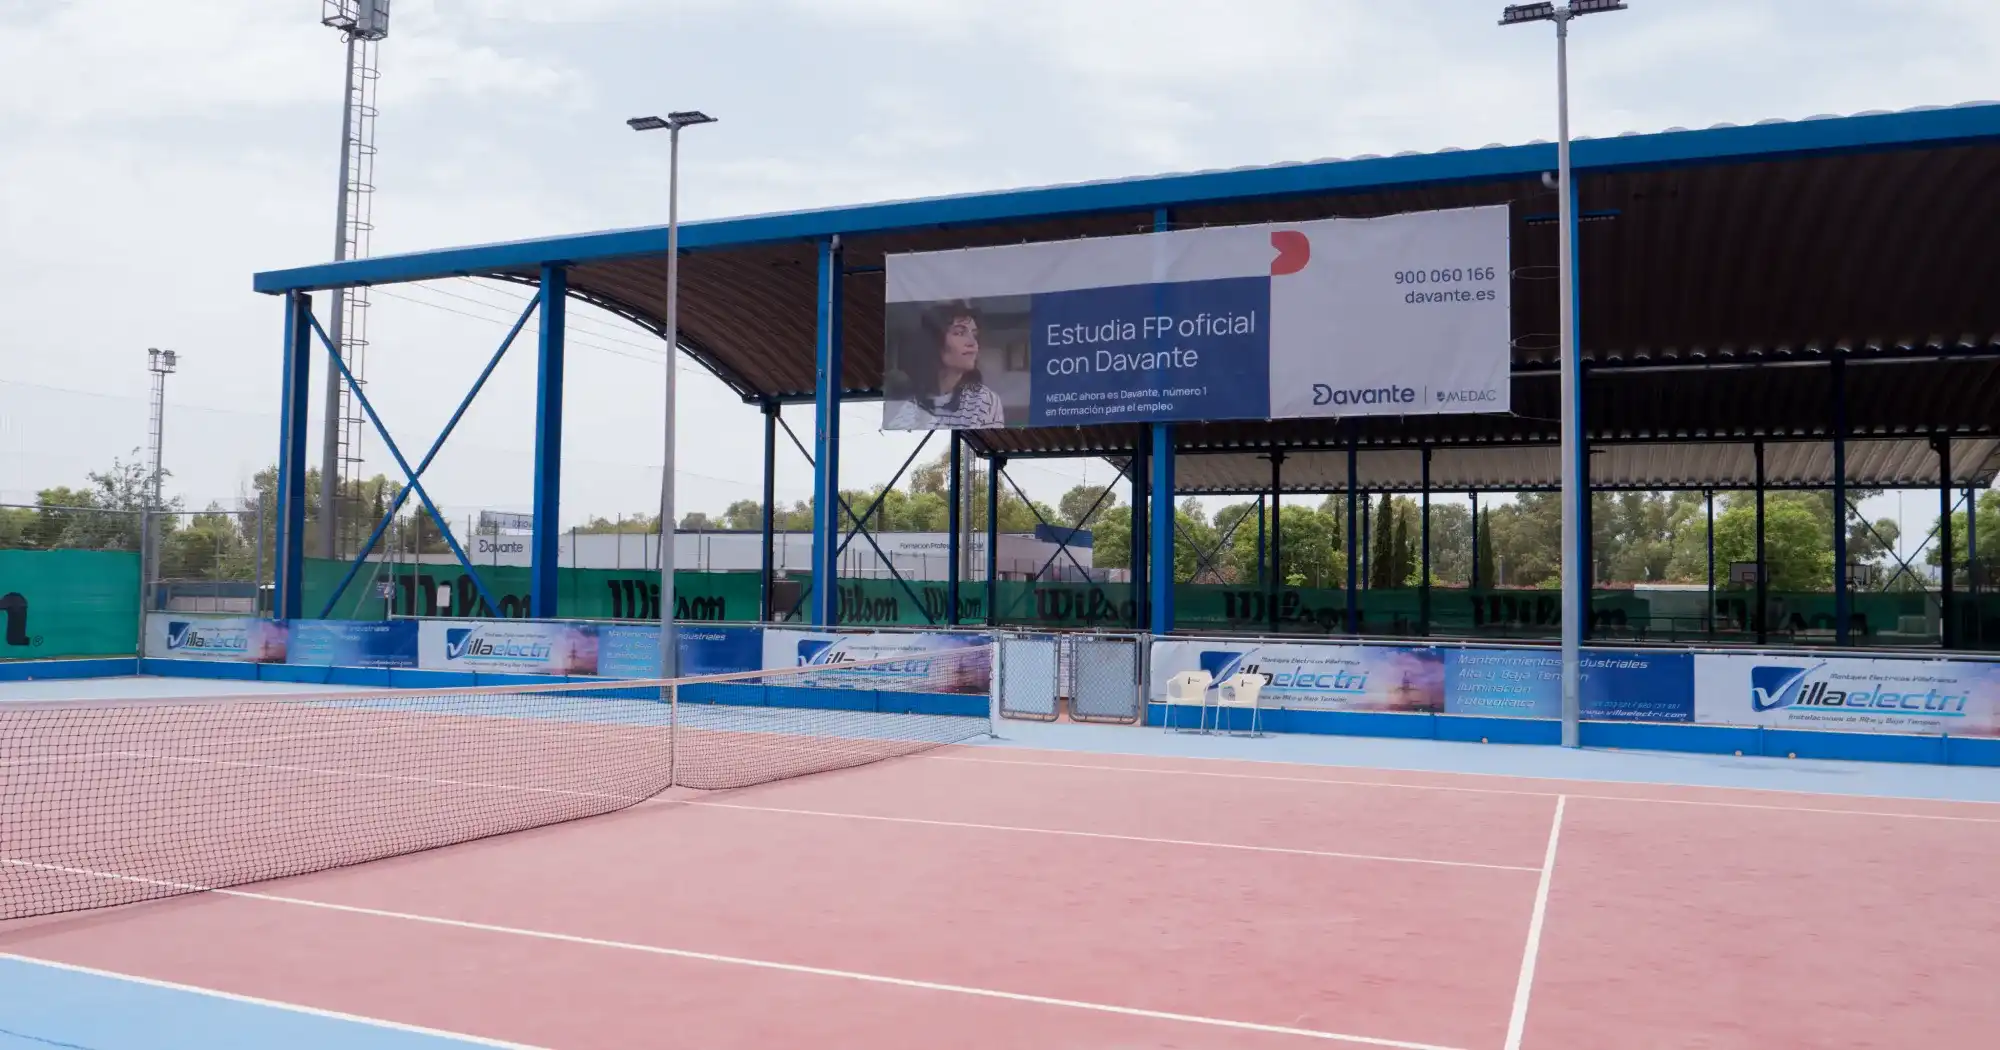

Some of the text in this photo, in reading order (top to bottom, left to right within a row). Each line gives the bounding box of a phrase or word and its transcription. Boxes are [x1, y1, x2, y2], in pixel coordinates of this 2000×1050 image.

[1394, 267, 1495, 284] 900 060 166
[1404, 288, 1496, 304] davante.es
[1047, 310, 1256, 346] Estudia FP oficial
[1046, 347, 1199, 376] con Davante
[1046, 392, 1078, 403] MEDAC
[1079, 390, 1106, 402] ahora
[1107, 391, 1119, 400] es
[1162, 387, 1201, 398] número
[1202, 386, 1208, 397] 1
[1312, 383, 1415, 405] Davante
[1444, 389, 1497, 403] MEDAC
[1045, 402, 1174, 418] en formación para el empleo
[478, 539, 523, 553] Davante
[1485, 671, 1496, 681] y
[1752, 662, 1970, 712] Villaelectri
